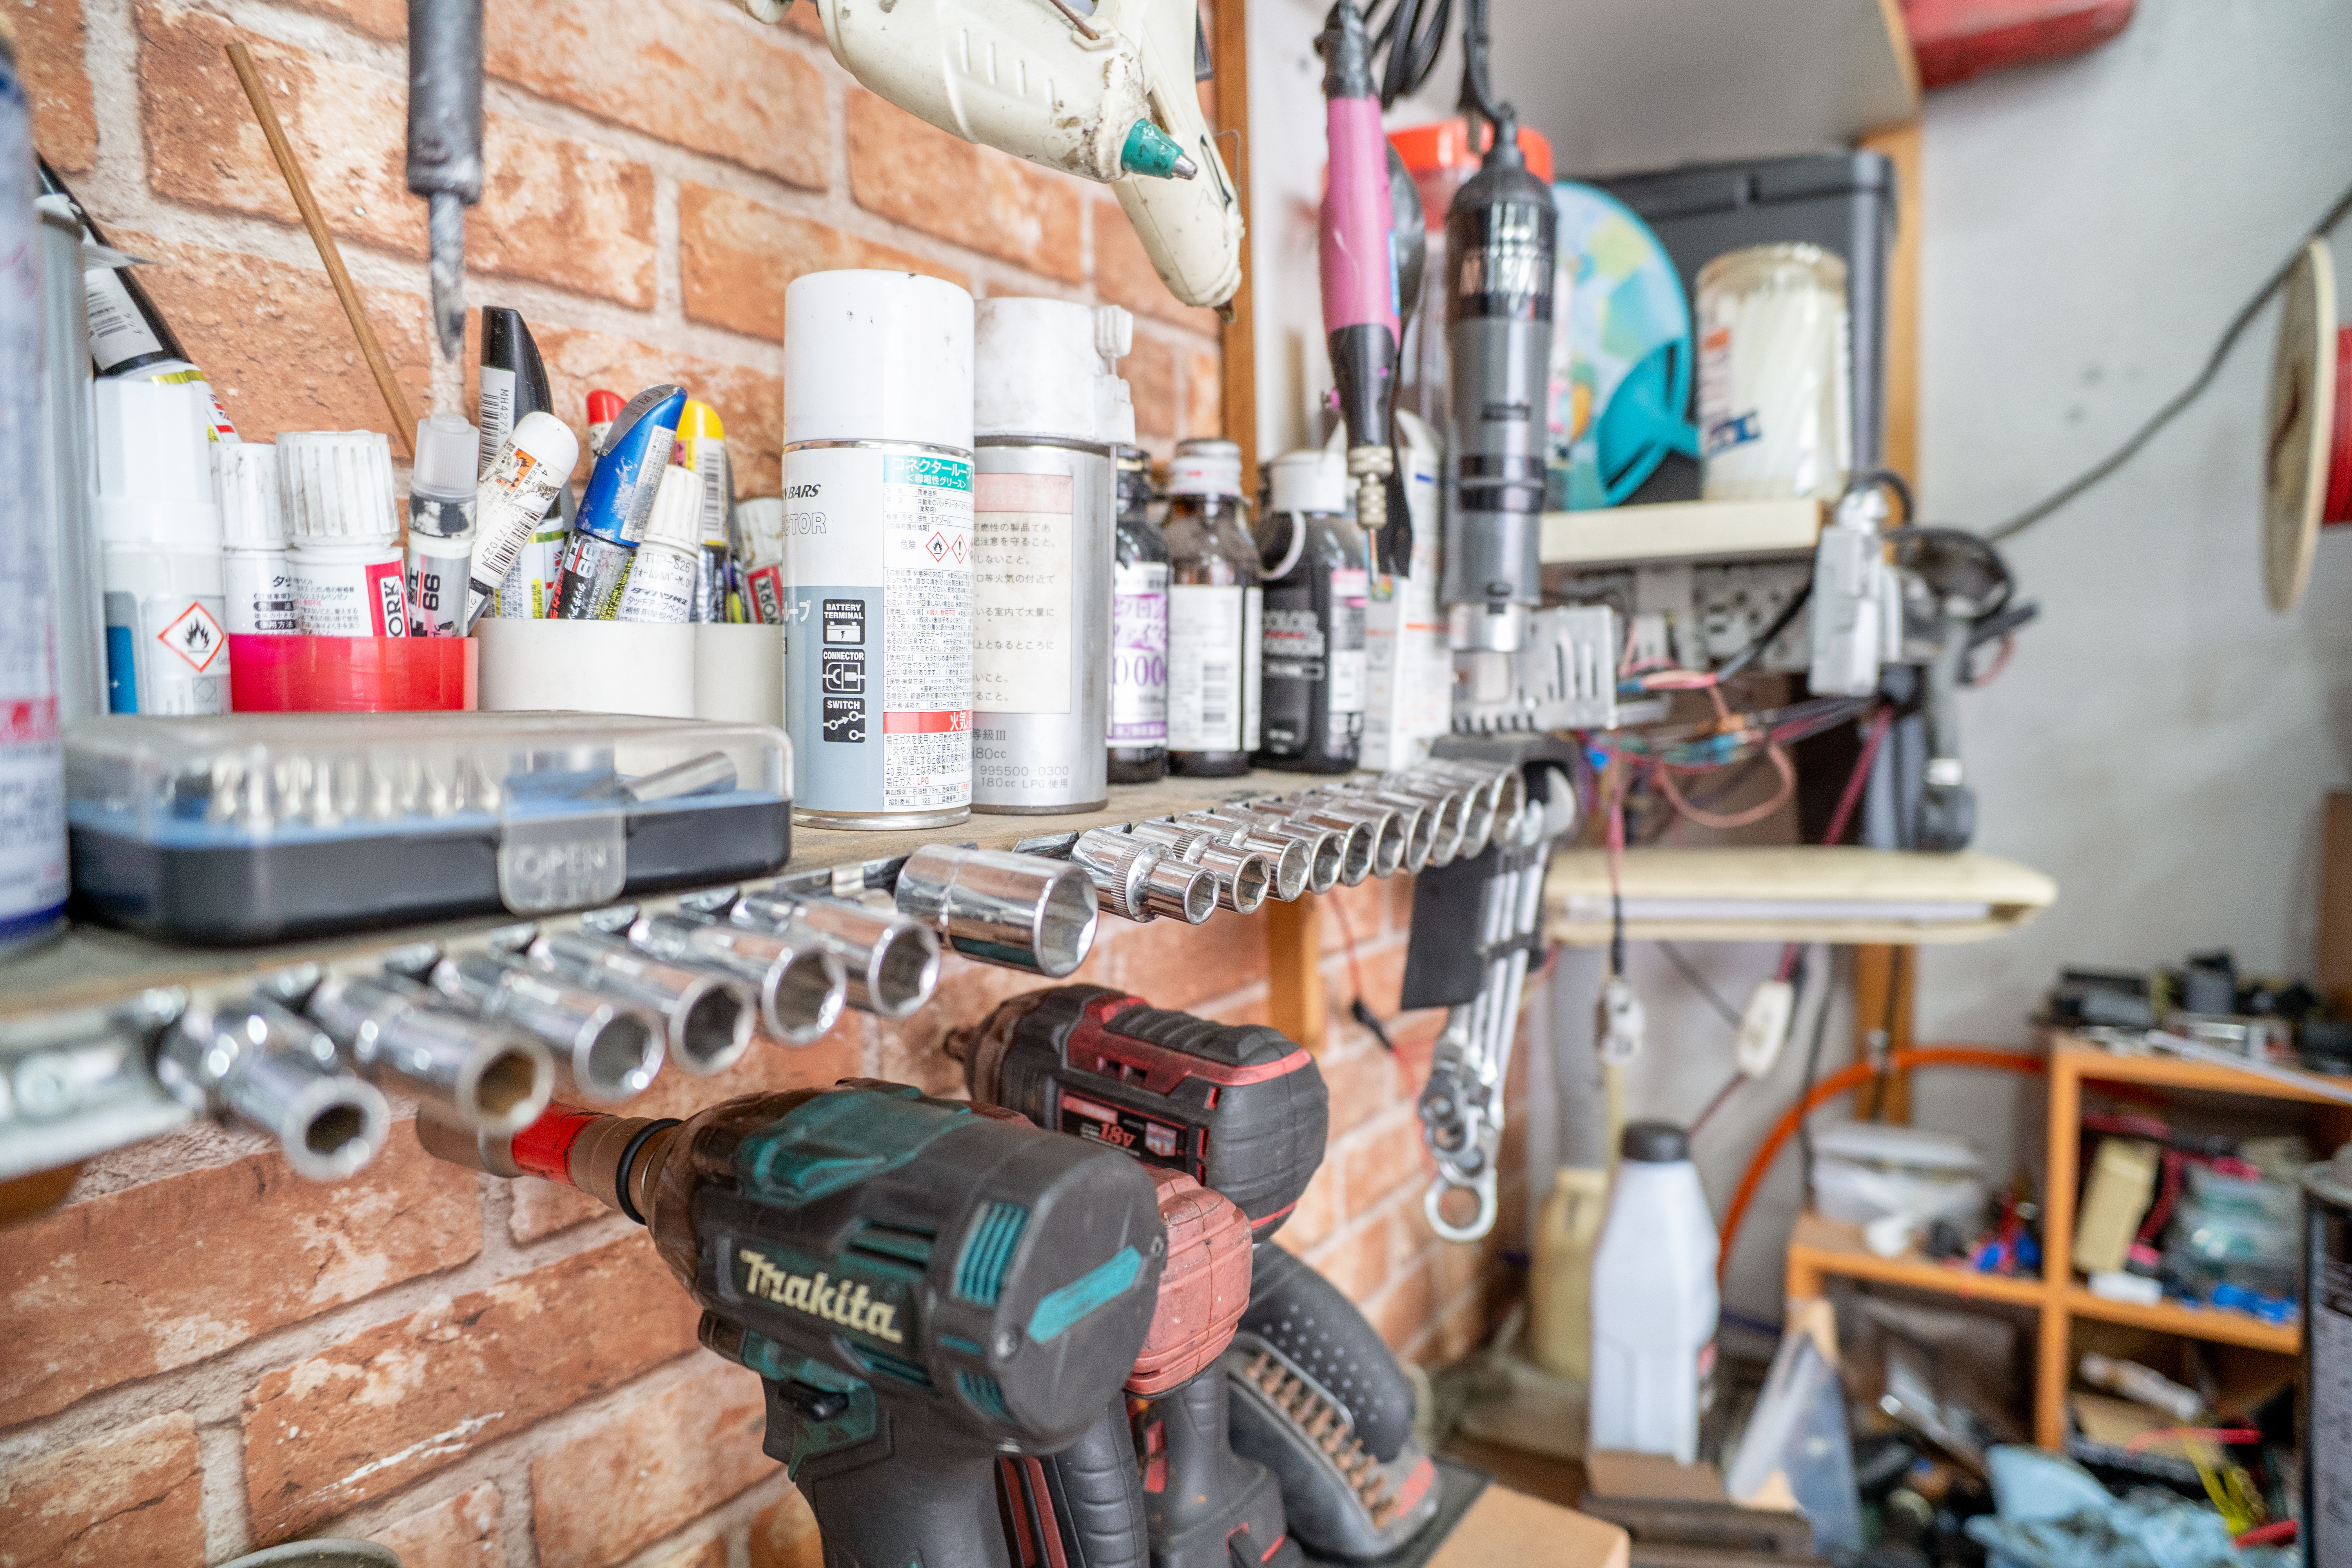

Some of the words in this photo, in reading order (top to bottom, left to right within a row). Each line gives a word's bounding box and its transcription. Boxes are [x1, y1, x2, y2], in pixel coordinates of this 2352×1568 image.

[500, 388, 509, 435] MH4273
[788, 484, 821, 499] BARS
[900, 540, 915, 550] 危険
[642, 552, 690, 573] TUP-S26
[975, 555, 1031, 565] しないこと。
[423, 573, 441, 611] 99
[592, 579, 602, 596] MADE
[973, 641, 1054, 650] 上となるところに
[823, 652, 864, 661] CONNECTOR
[973, 673, 1009, 683] いこと。
[973, 692, 1009, 702] ること。
[827, 701, 860, 709] SWITCH
[973, 748, 1007, 759] 80cc
[980, 765, 1069, 777] 995500-0300
[981, 777, 1016, 788] 180cc
[1023, 779, 1045, 788] LPG
[1049, 779, 1068, 789] 使用
[740, 1249, 902, 1343] makita
